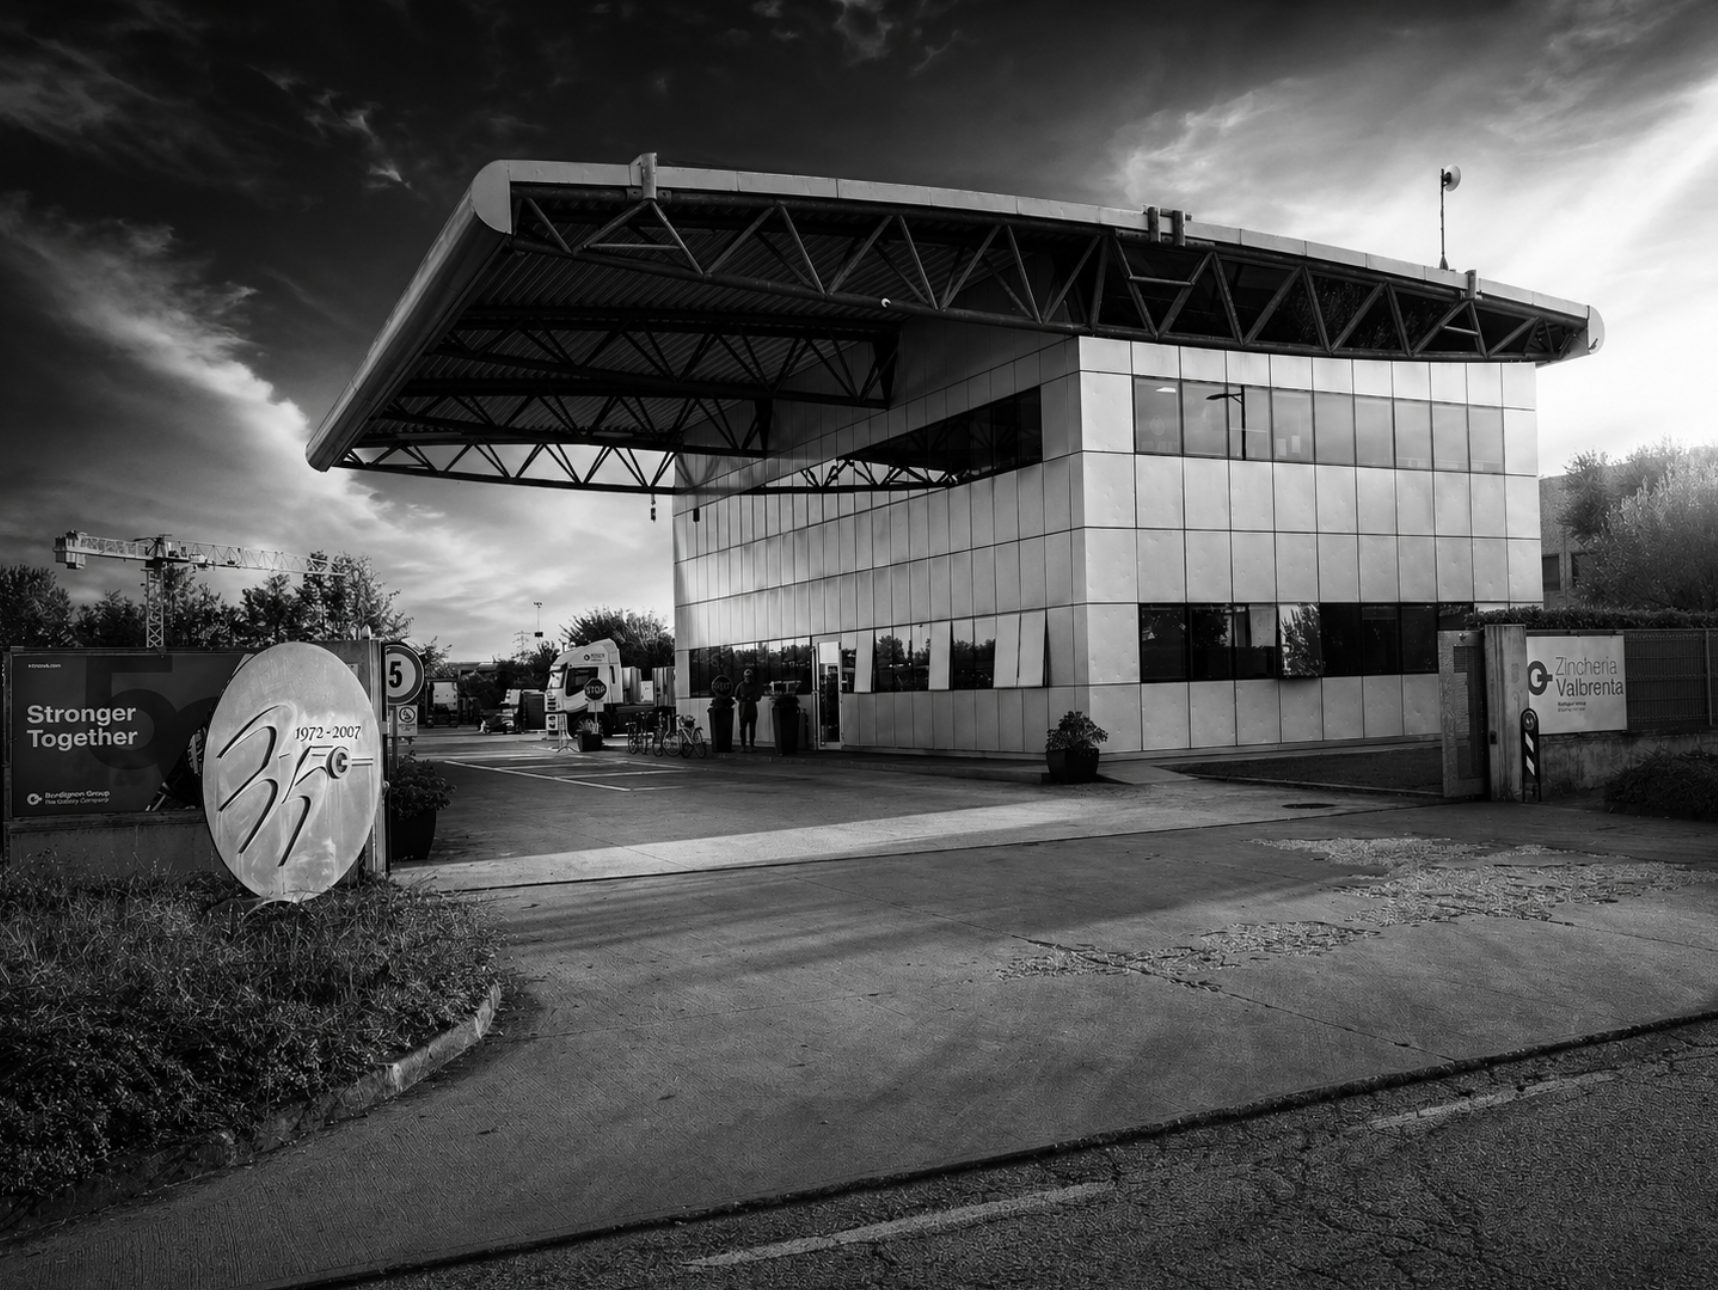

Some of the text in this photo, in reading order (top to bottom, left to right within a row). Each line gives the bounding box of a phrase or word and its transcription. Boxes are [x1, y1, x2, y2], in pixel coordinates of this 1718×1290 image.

[388, 661, 402, 688] 5
[1555, 656, 1618, 676] Zincheria
[586, 685, 606, 694] STOP
[1556, 678, 1625, 697] Valbrenta
[27, 705, 136, 726] Stronger
[26, 728, 138, 751] Together
